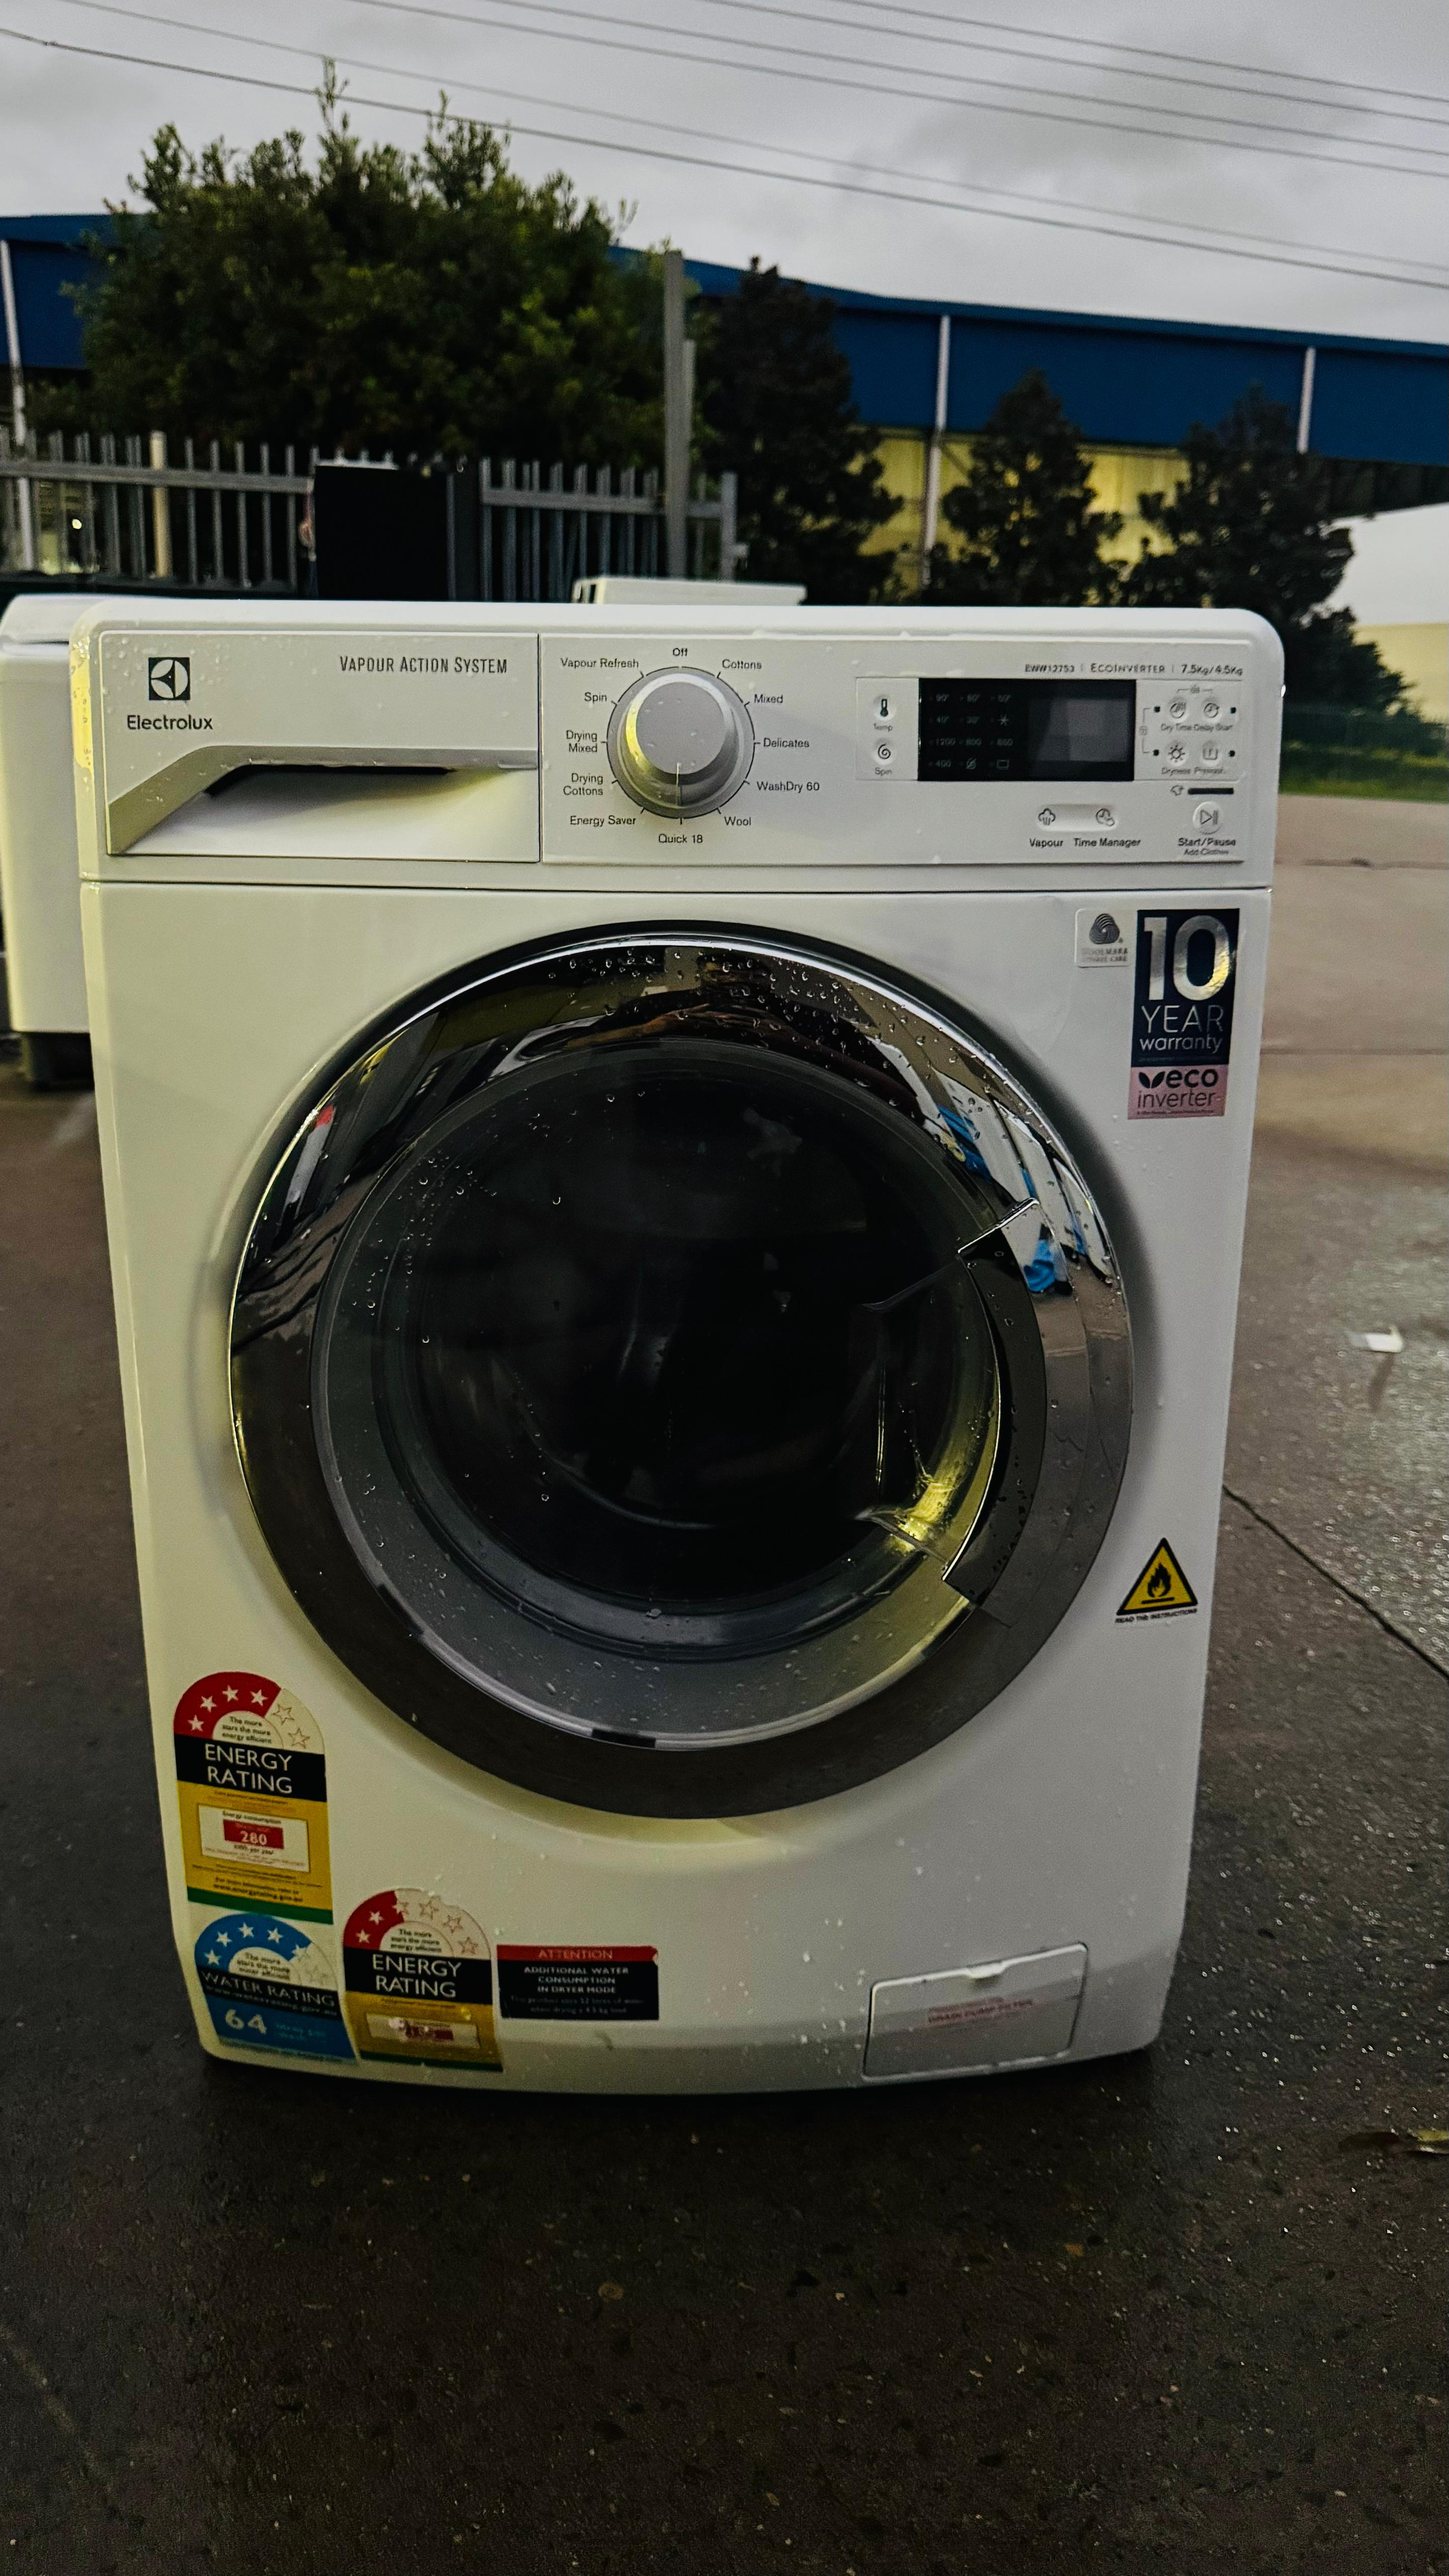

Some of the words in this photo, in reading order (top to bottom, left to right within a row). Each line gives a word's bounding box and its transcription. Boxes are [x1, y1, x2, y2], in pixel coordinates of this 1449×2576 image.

[673, 648, 688, 657] Off
[340, 656, 394, 672] VAPOUR
[400, 656, 449, 673] ACTION
[454, 657, 508, 673] SYSTEM
[560, 658, 596, 668] Vapour
[600, 658, 639, 668] Refresh
[722, 659, 762, 670] Cottons
[584, 692, 607, 703] Spin
[754, 694, 783, 704] Mixed
[127, 714, 213, 731] Electrolux
[566, 731, 598, 742] Drying
[569, 744, 598, 753] Mixed
[763, 738, 810, 748] Delicates
[571, 773, 603, 785] Drying
[563, 786, 603, 796] Cottons
[757, 781, 803, 793] WashDry
[806, 781, 820, 791] 60
[570, 816, 605, 827] Energy
[608, 816, 636, 826] Saver
[725, 817, 752, 826] Wool
[659, 834, 687, 844] Quick
[692, 834, 703, 844] 18
[1029, 838, 1064, 848] Vapour
[1074, 838, 1097, 847] Time
[1099, 838, 1141, 848] Manager
[1178, 837, 1236, 846] Start/Pause
[1144, 915, 1230, 1001] 10
[1141, 1005, 1224, 1033] YEAR
[1140, 1035, 1224, 1054] warranty
[1166, 1069, 1219, 1088] eco
[1138, 1089, 1217, 1108] inverter
[229, 1716, 243, 1724] The
[204, 1743, 292, 1772] ENERGY
[207, 1765, 293, 1795] RATING
[239, 1830, 268, 1846] 280
[538, 1949, 613, 1960] ATTENTION
[372, 1954, 462, 1977] ENERGY
[524, 1966, 587, 1975] ADDITIONAL
[591, 1966, 629, 1975] WATER
[538, 1976, 616, 1984] CONSUMPTION
[200, 1969, 263, 1994] WATER
[266, 1984, 335, 2008] RATING
[375, 1975, 457, 1998] RATING
[586, 1986, 616, 1994] MODE
[224, 2008, 268, 2036] 64
